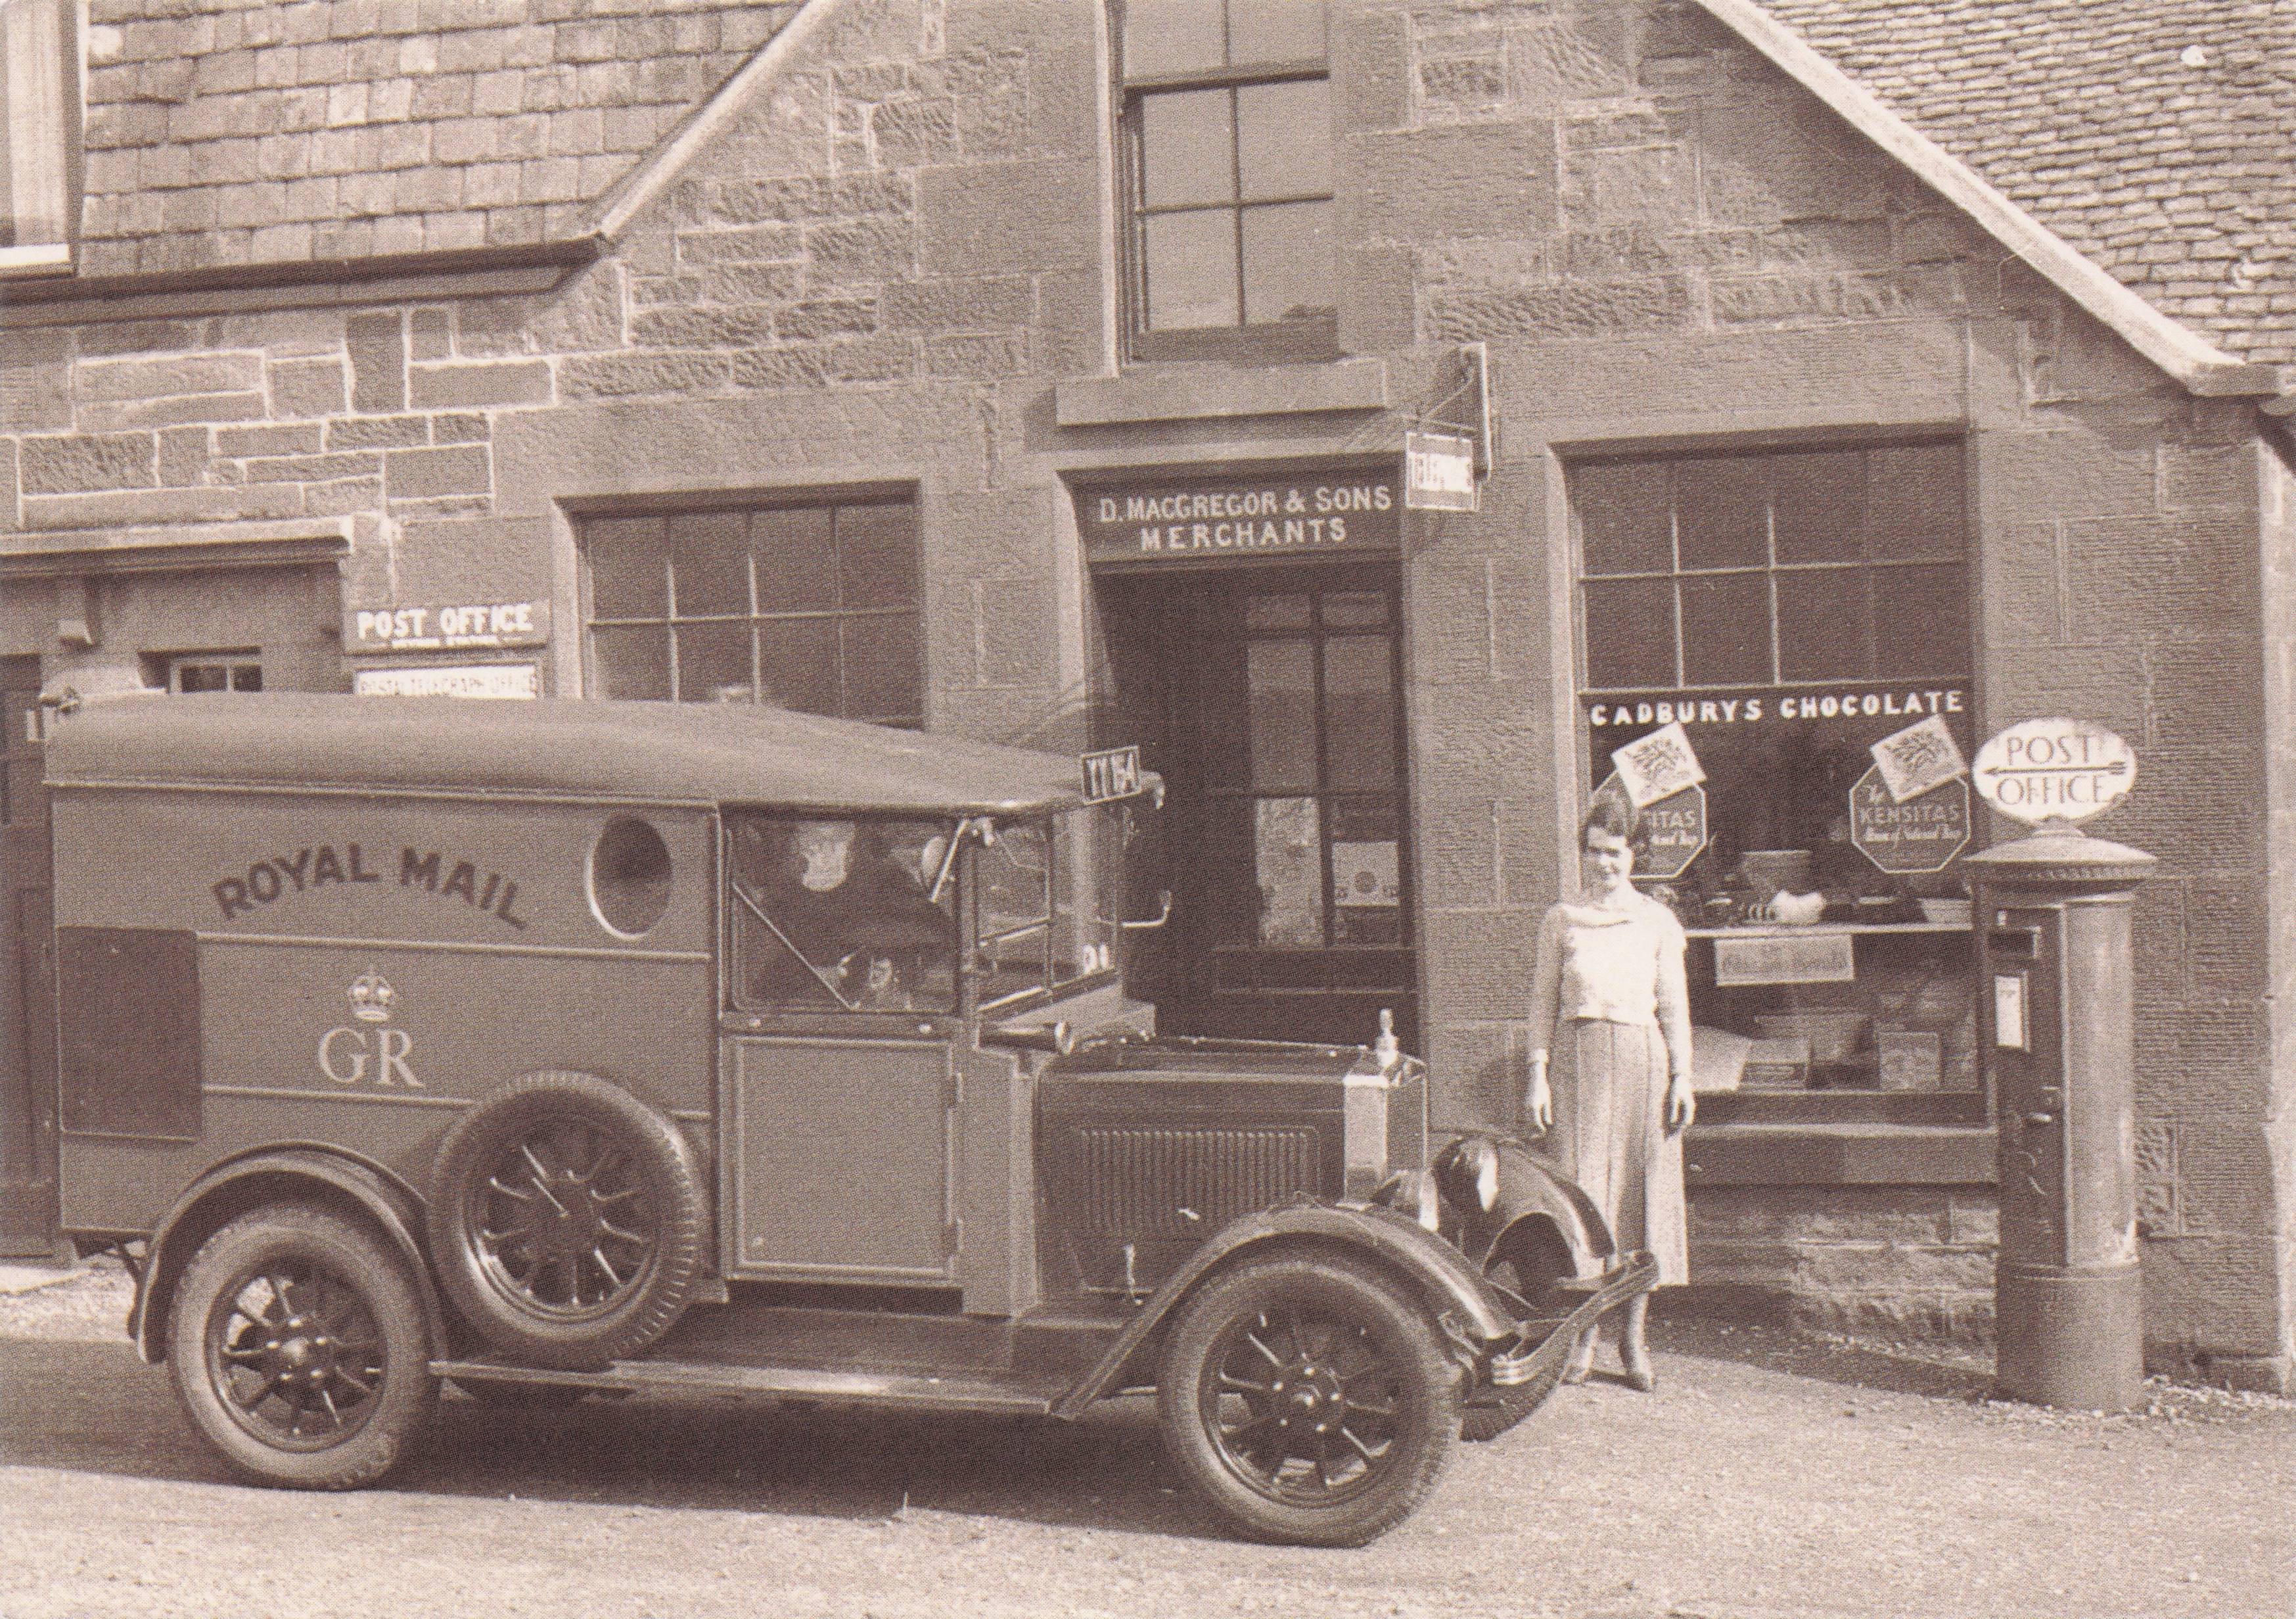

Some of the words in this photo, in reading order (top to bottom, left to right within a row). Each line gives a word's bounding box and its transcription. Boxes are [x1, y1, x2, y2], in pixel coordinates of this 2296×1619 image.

[1126, 491, 1277, 521] MACGREGOR
[1285, 488, 1306, 513] &
[1314, 485, 1392, 512] SONS
[1140, 517, 1346, 551] MERCHANTS
[356, 609, 427, 640] POST
[440, 603, 533, 636] OFFICE
[1590, 698, 1763, 726] CADBURYS
[1779, 690, 1964, 719] CHOCOLATE
[2006, 735, 2094, 766] POST
[1996, 774, 2109, 806] OFFICE
[1859, 804, 1961, 824] KENSITAS
[210, 842, 382, 920] ROYAL
[398, 846, 526, 931] MAIL
[317, 1025, 426, 1089] GR
